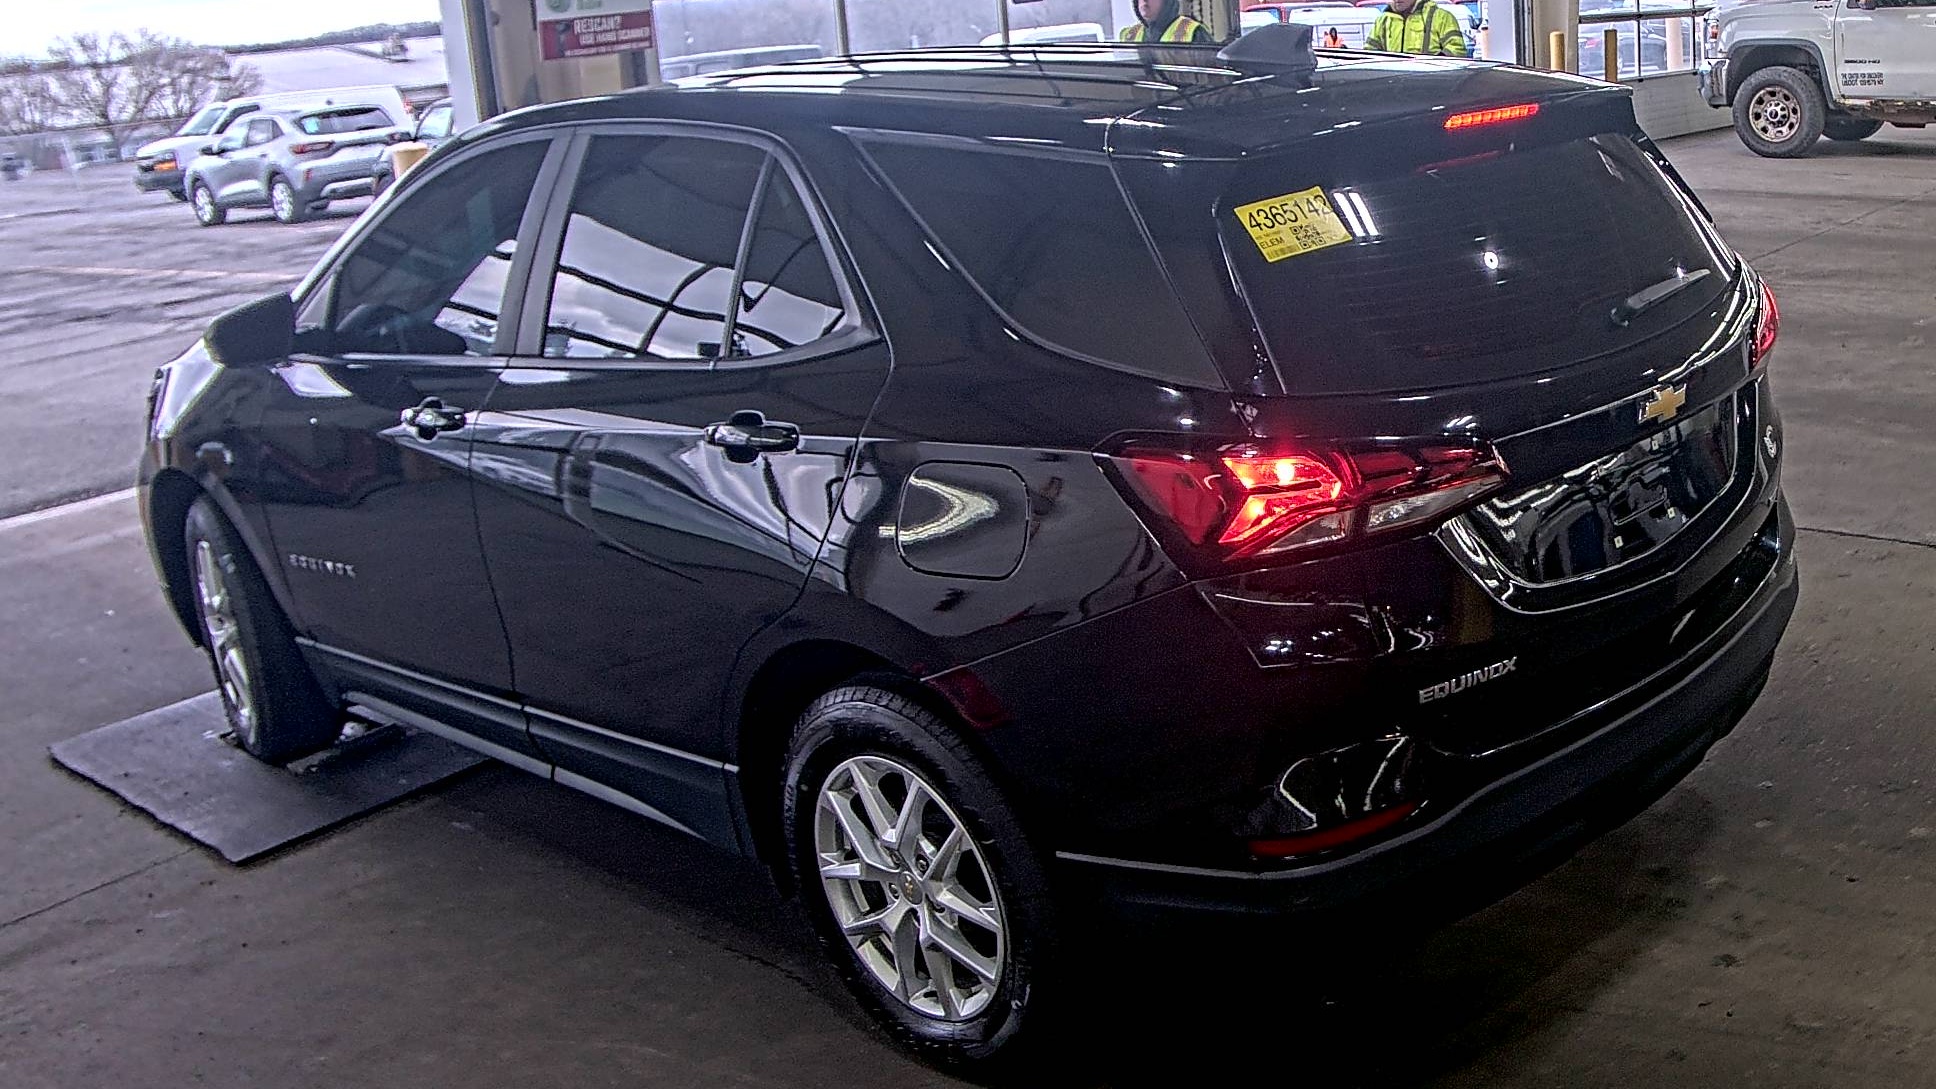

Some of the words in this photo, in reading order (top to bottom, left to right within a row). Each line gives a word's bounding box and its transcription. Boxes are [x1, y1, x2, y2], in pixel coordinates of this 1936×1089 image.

[1248, 194, 1331, 231] 4365142
[288, 553, 356, 578] EQUINOX
[1418, 656, 1518, 704] EQUINOX
